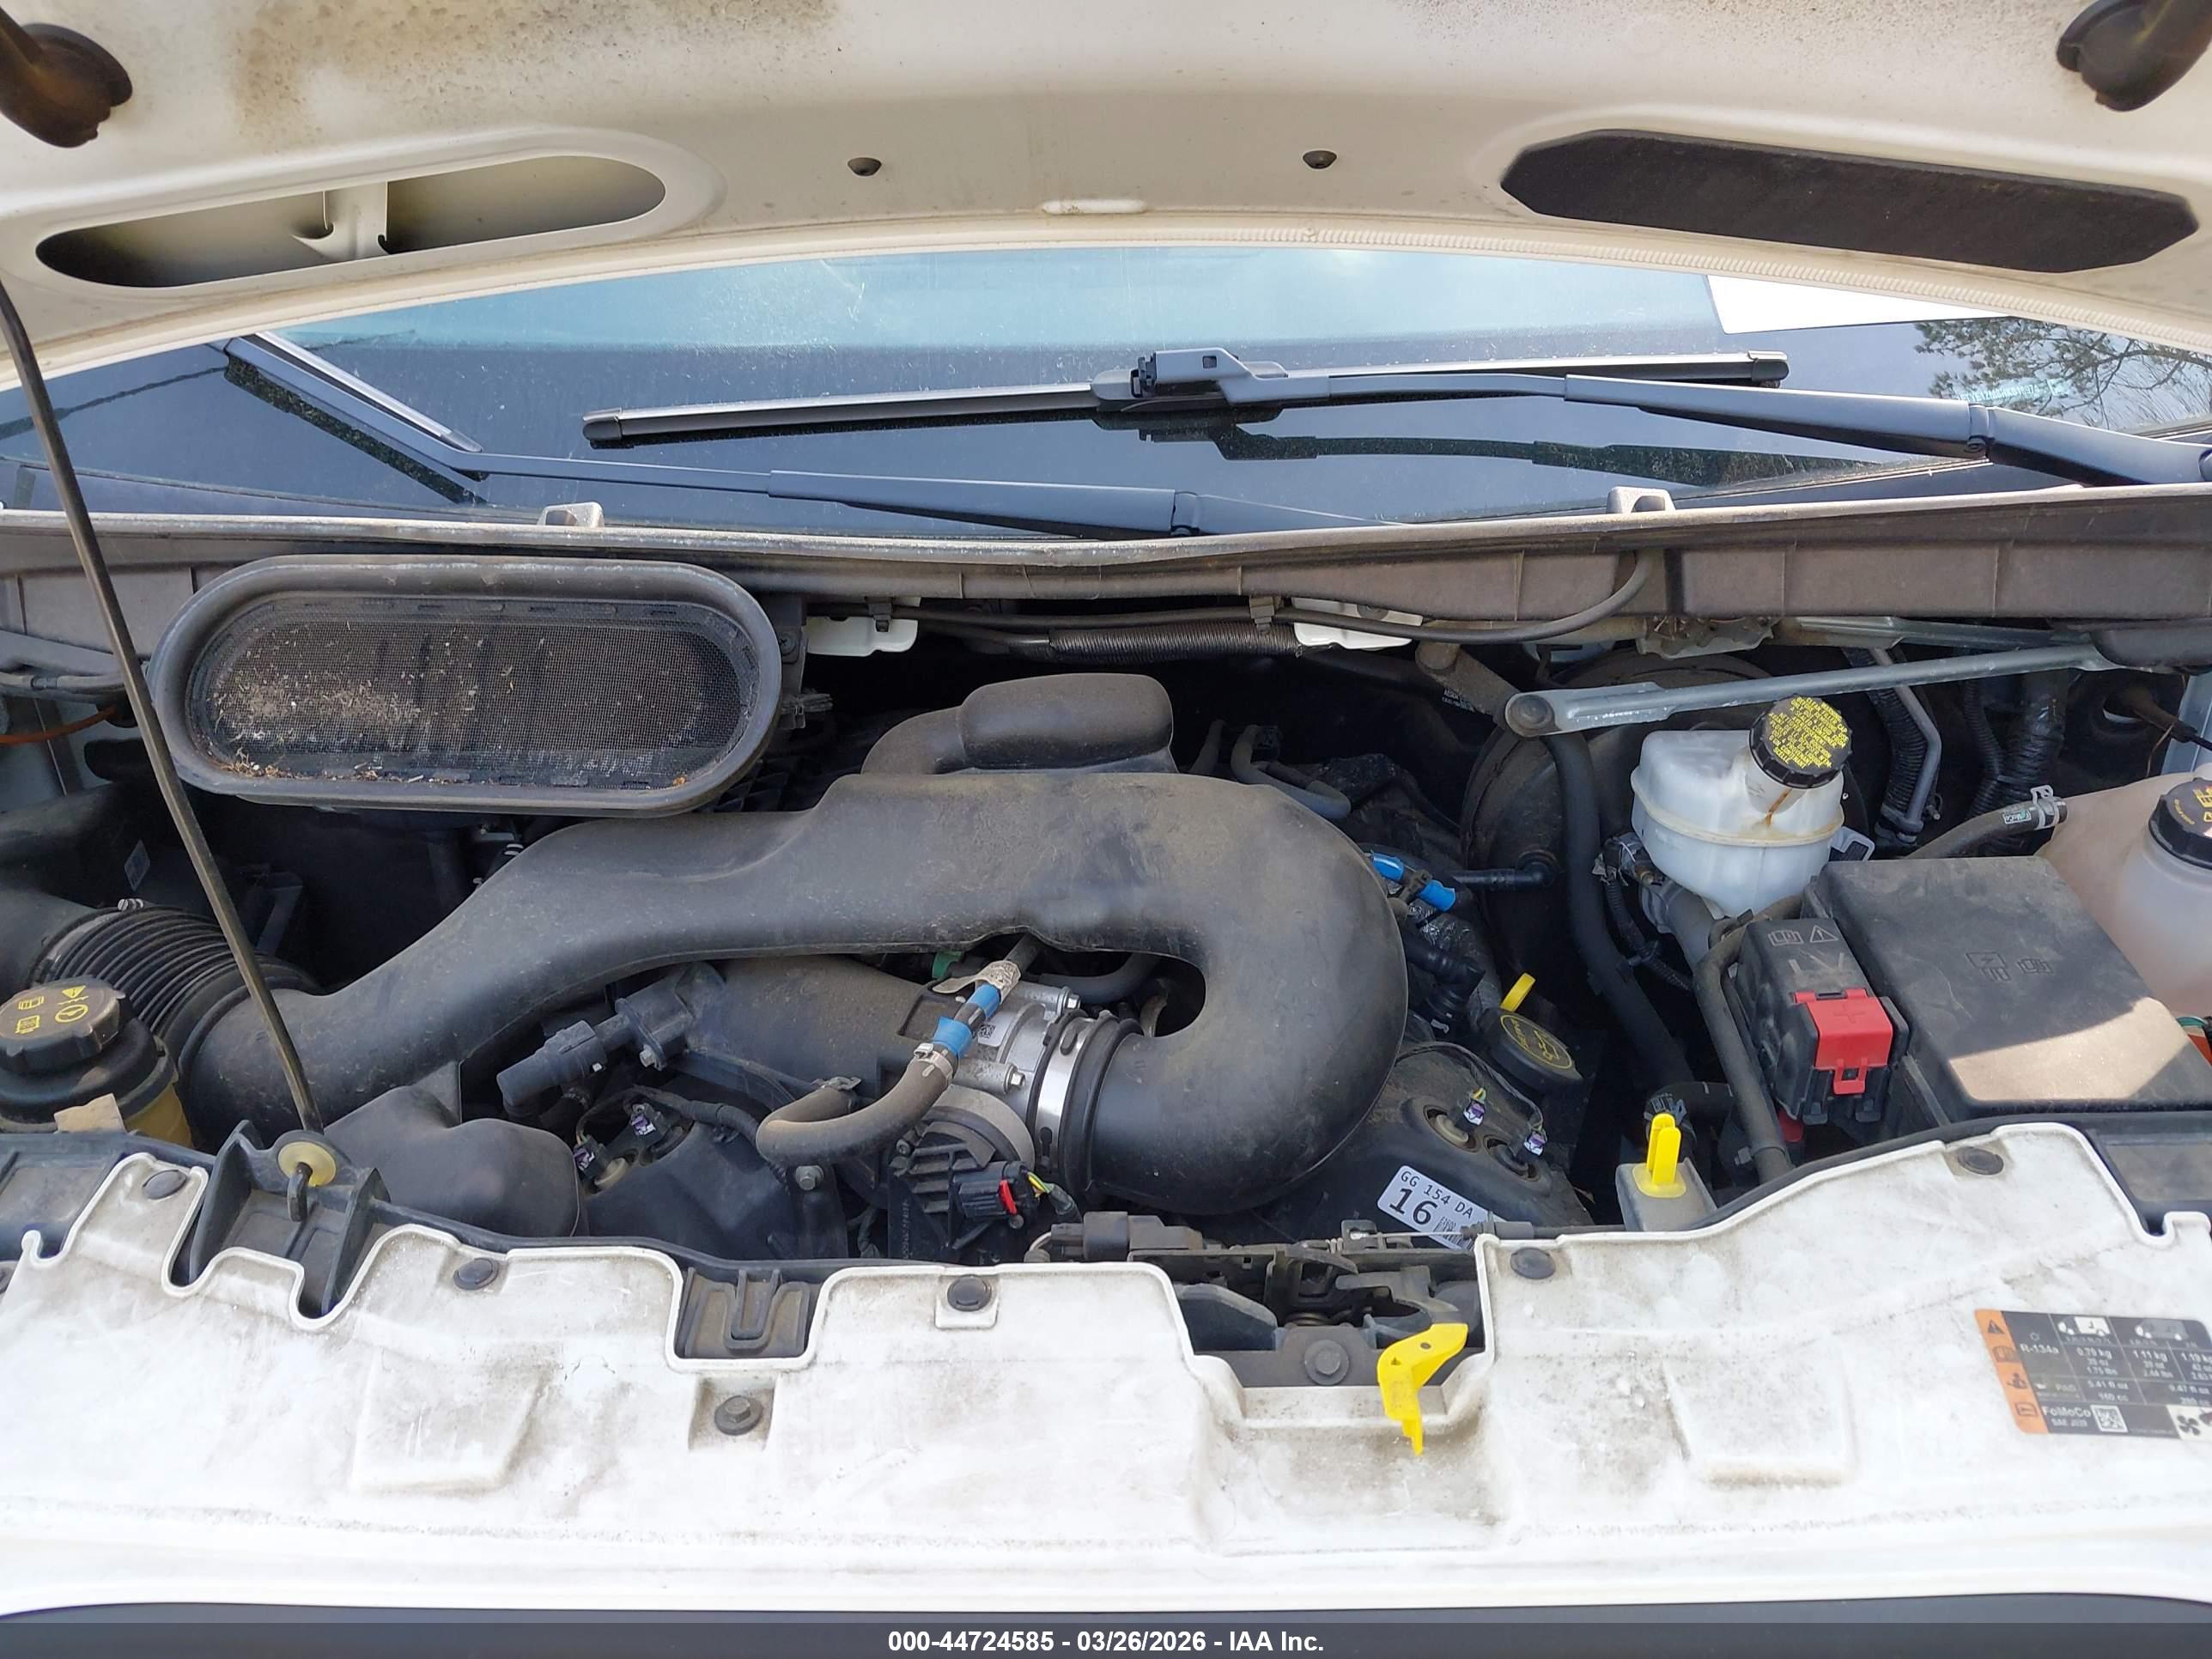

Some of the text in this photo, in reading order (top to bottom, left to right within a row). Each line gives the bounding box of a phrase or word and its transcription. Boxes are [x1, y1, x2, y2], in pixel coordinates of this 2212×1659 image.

[1837, 723, 1848, 733] CAP
[1401, 1171, 1473, 1219] GG 154 DA
[1389, 1188, 1438, 1225] 16
[2020, 1343, 2059, 1353] R-134a
[2098, 1349, 2112, 1359] kg
[2133, 1350, 2168, 1362] 1.11 kg
[2042, 1405, 2092, 1418] FoMoCo
